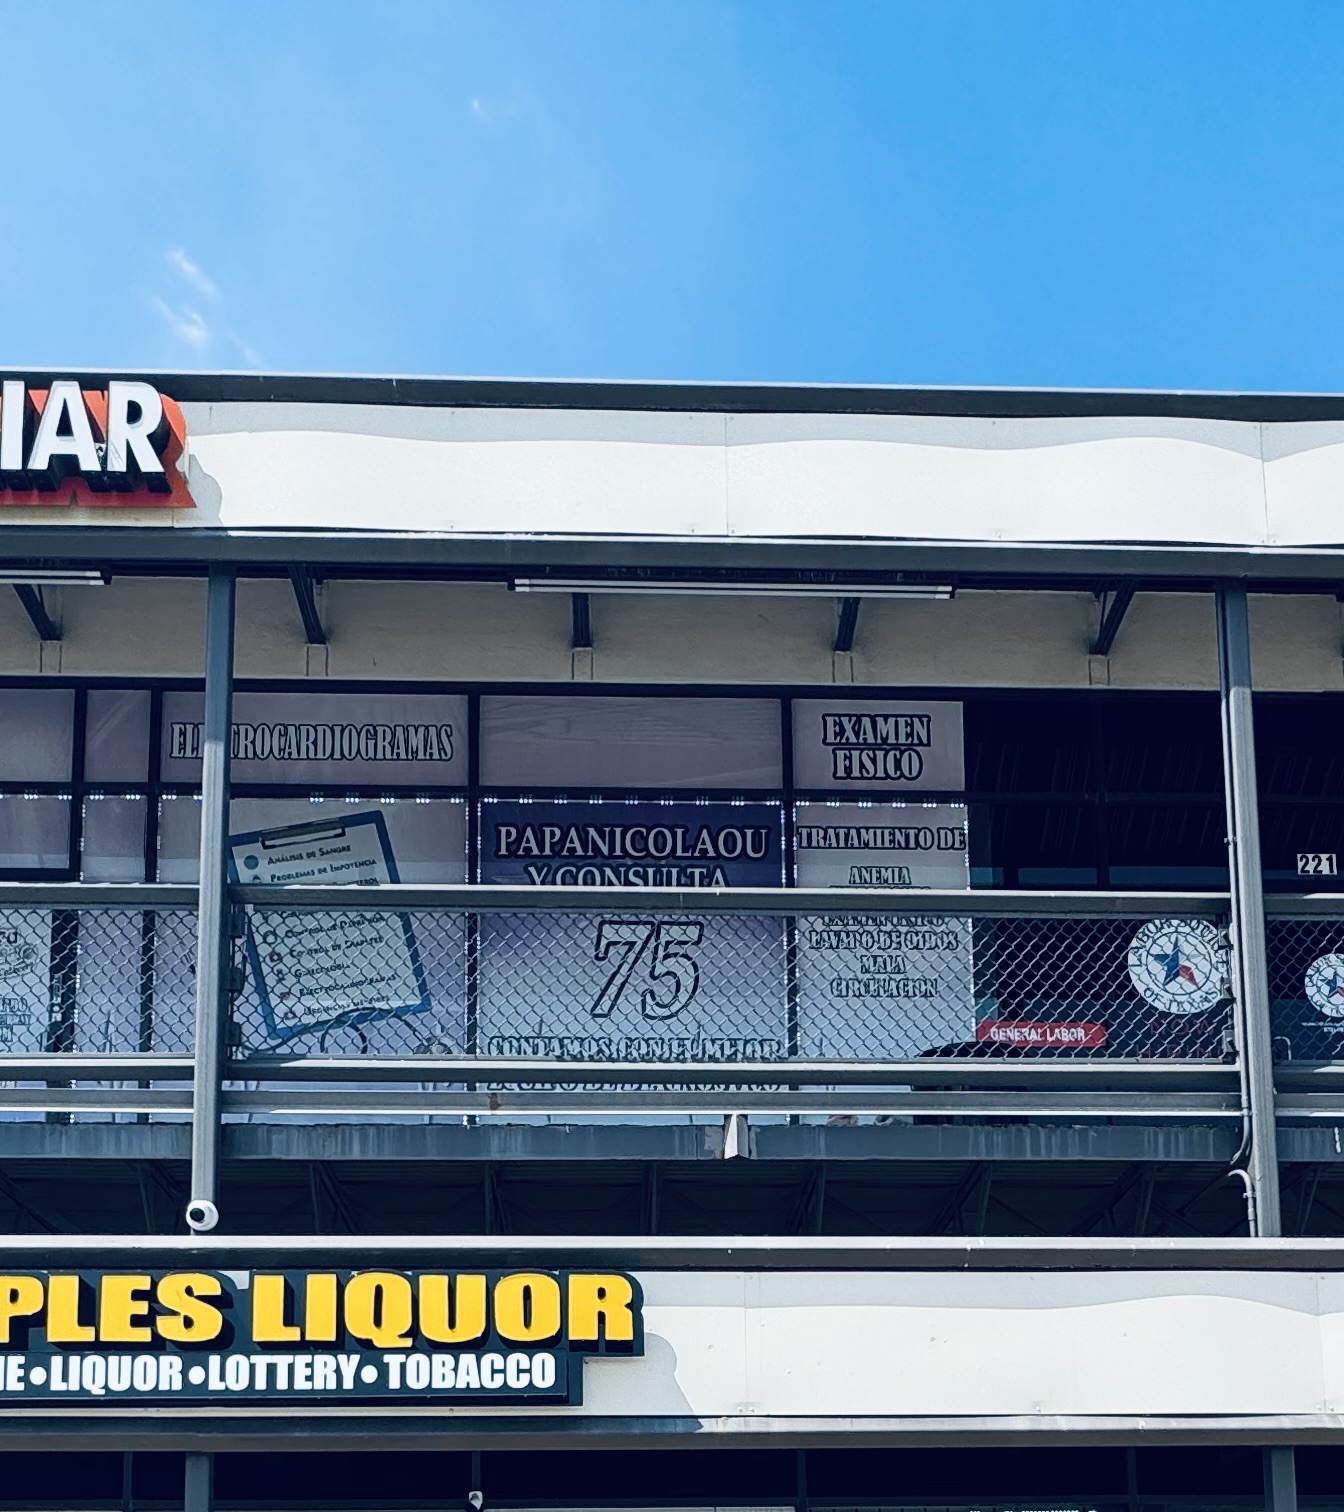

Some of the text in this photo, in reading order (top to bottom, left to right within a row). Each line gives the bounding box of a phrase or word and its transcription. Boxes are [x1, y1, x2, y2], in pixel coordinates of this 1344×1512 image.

[822, 712, 932, 747] EXAMEN
[833, 748, 923, 780] FISICO
[495, 823, 771, 860] PAPANICOLAOU
[797, 826, 966, 850] TRATAMIENTO DE
[555, 866, 727, 887] CONSULTA
[849, 866, 912, 885] ANEMIA
[1299, 855, 1337, 875] 221
[590, 919, 705, 1021] 75
[990, 1028, 1086, 1042] GENERAL LABOR
[250, 1273, 637, 1349] LIQUOR
[50, 1354, 183, 1391] LIQUOR
[207, 1354, 359, 1391] LOTTERY
[387, 1353, 556, 1390] TOBACCO
